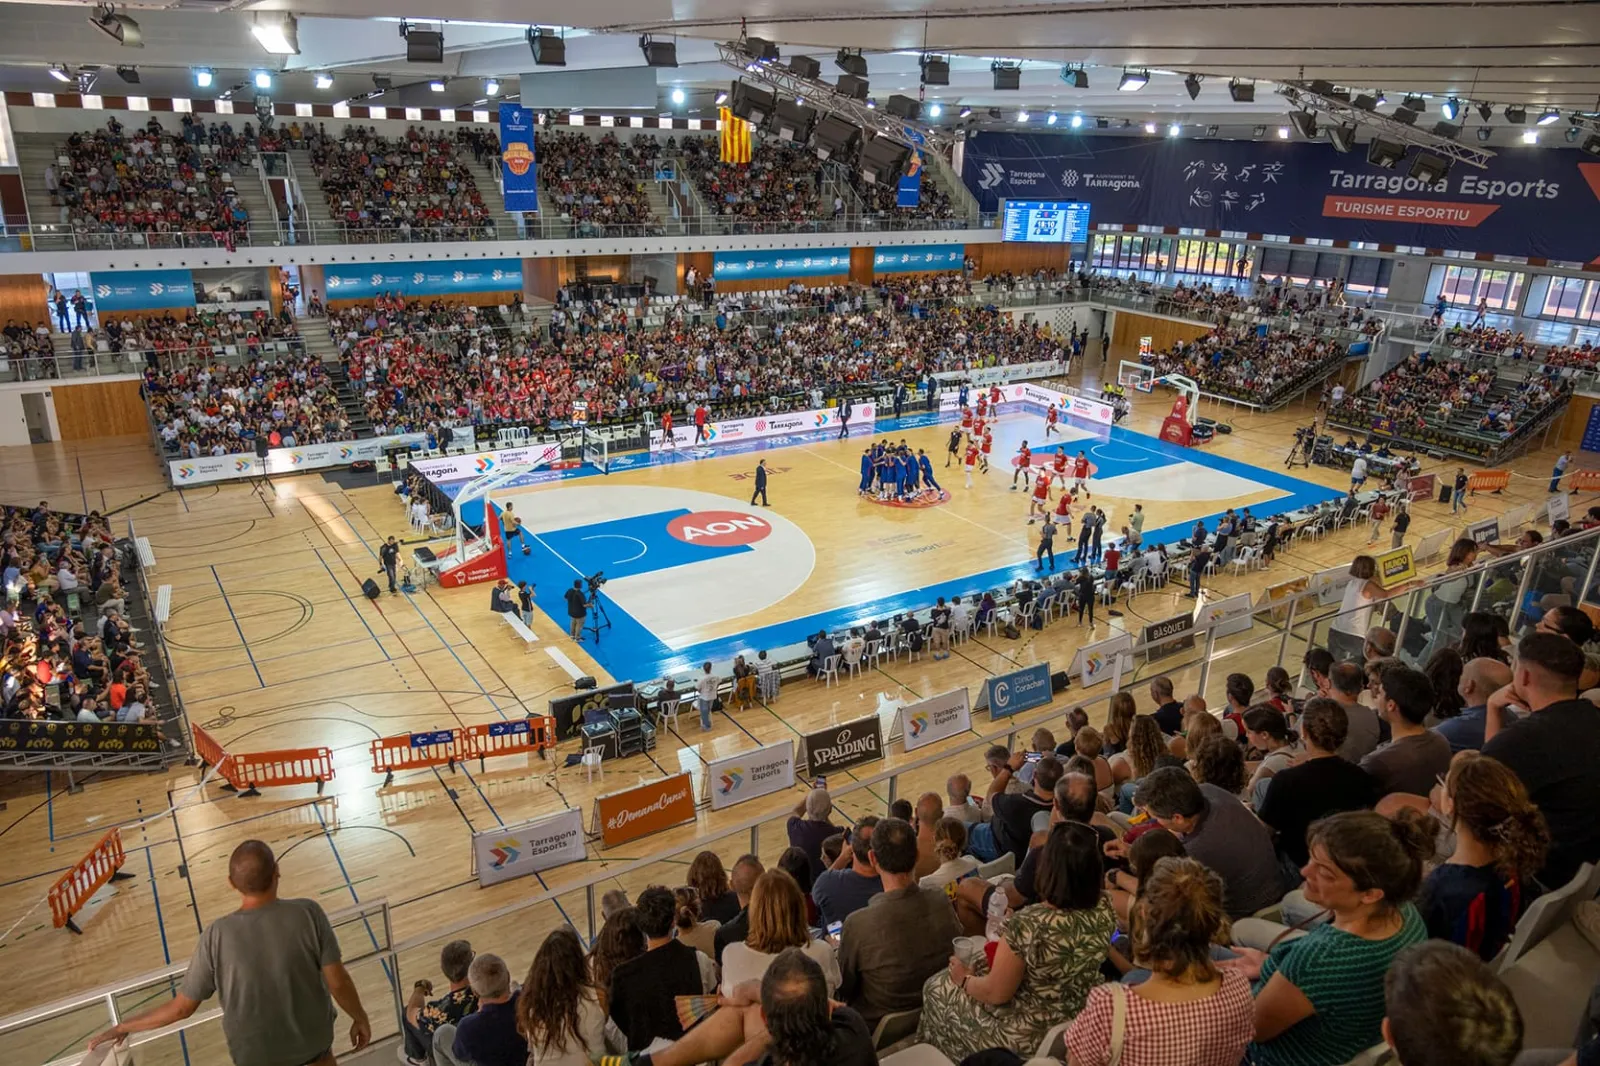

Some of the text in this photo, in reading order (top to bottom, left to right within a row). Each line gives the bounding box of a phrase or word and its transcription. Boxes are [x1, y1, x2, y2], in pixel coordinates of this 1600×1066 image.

[1010, 170, 1045, 180] Tarragona
[1010, 178, 1037, 186] Esports
[1459, 175, 1560, 199] Esports
[1335, 201, 1471, 221] TURISME ESPORTIU
[500, 450, 528, 459] Tarragona
[683, 516, 766, 541] AON
[1015, 679, 1046, 693] Corachan
[932, 703, 964, 719] Tarragona
[934, 713, 959, 727] Esports
[813, 732, 877, 767] SPALDING
[750, 758, 790, 775] Tarragona
[751, 767, 782, 782] Esports
[528, 828, 578, 848] Tarragona
[531, 839, 568, 857] Esports
